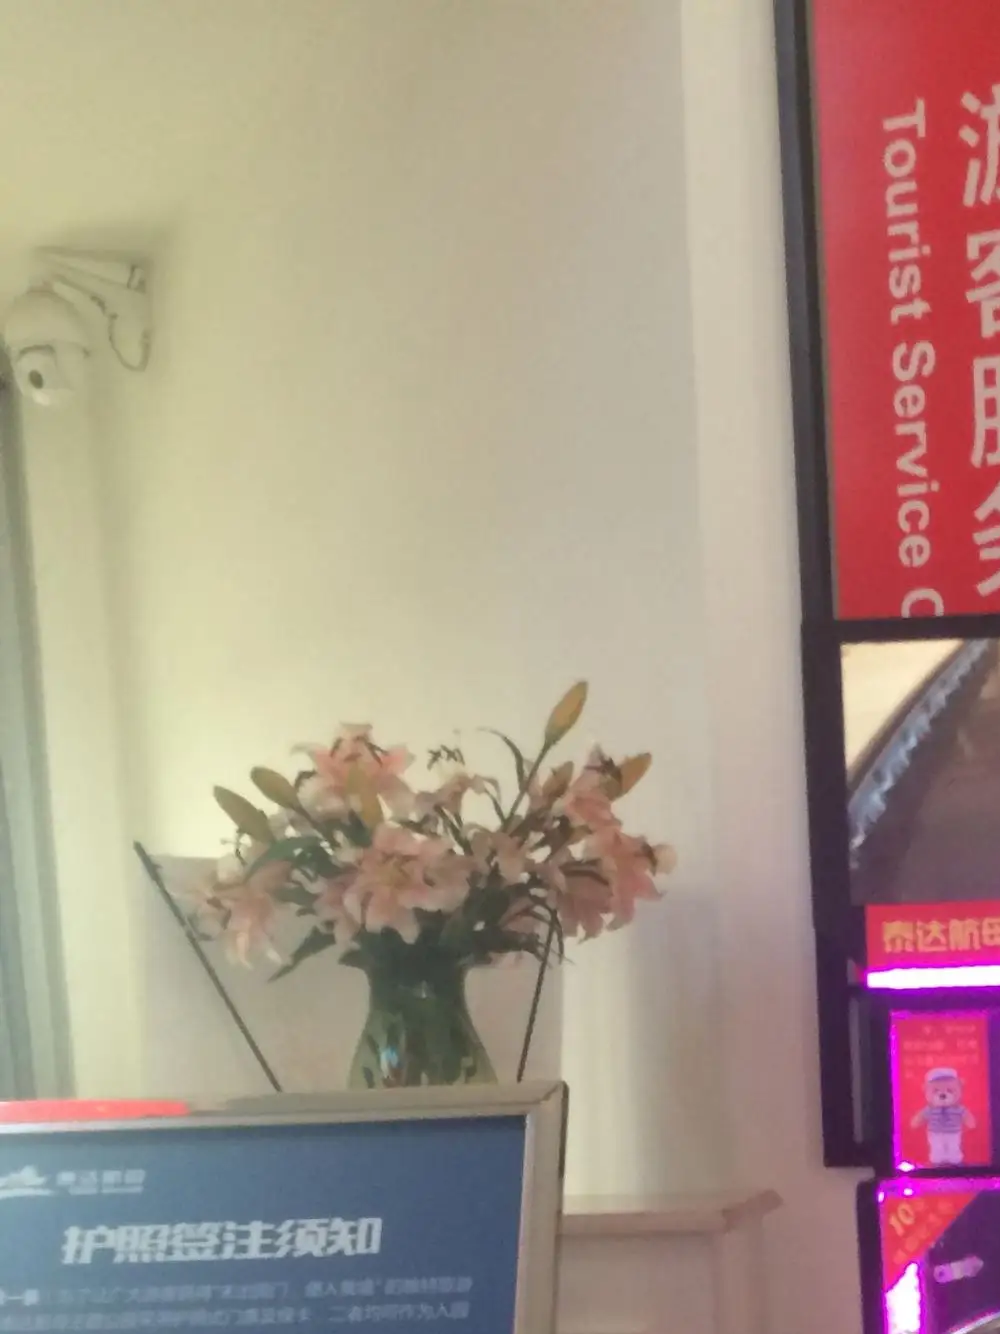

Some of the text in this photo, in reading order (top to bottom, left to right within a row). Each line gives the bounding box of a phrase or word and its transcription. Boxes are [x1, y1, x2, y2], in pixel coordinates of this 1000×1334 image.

[882, 98, 932, 325] Tourist
[892, 340, 940, 568] Service
[61, 1217, 383, 1264] 护照签注须知
